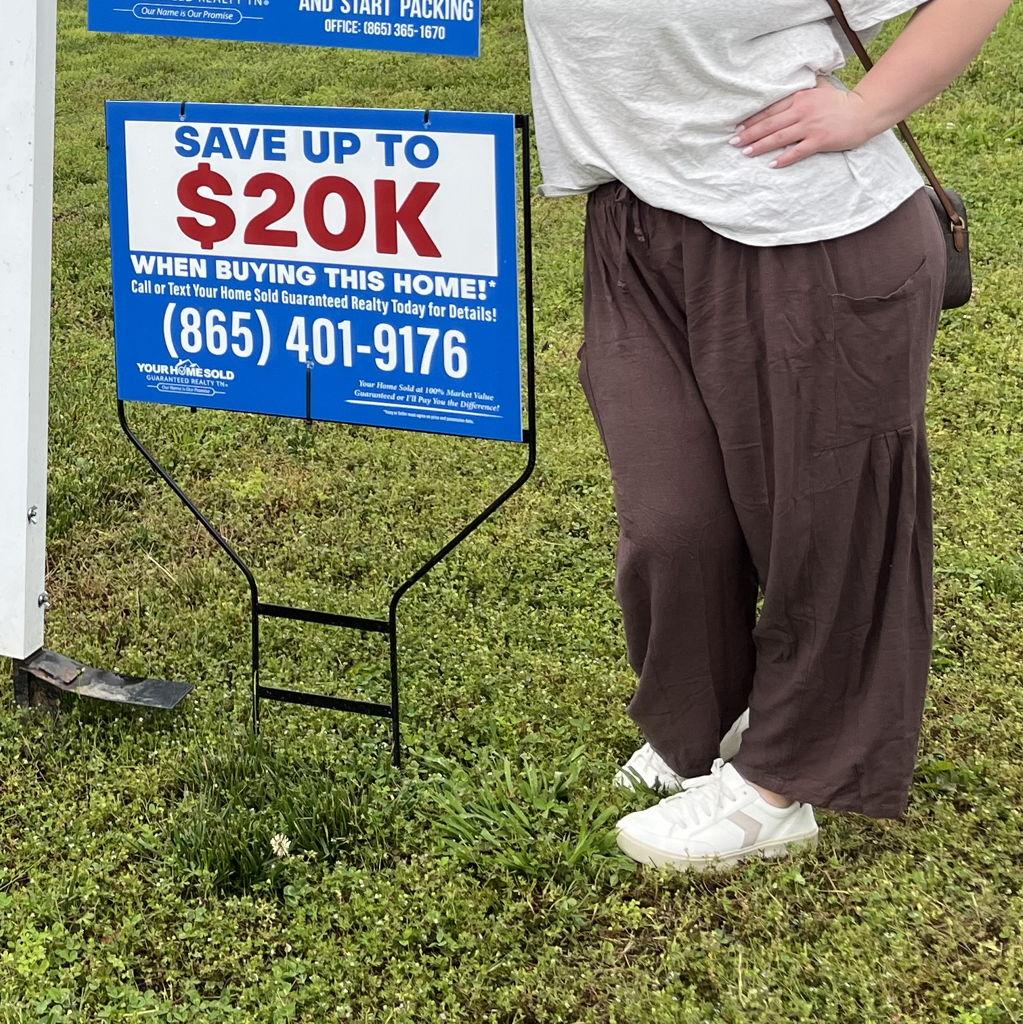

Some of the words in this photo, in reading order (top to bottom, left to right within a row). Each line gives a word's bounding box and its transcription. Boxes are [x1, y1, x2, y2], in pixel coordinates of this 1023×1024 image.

[141, 6, 156, 15] Our
[156, 8, 179, 17] Name
[187, 9, 202, 18] Our
[203, 10, 233, 20] Promise
[325, 19, 361, 34] OFFICE:
[364, 21, 392, 36] (865)
[394, 23, 445, 40] 365-1670
[175, 126, 286, 161] SAVE
[303, 130, 361, 164] UP
[376, 133, 439, 169] TO
[177, 162, 442, 258] $20K
[130, 254, 207, 278] WHEN
[216, 260, 317, 286] BUYING
[324, 267, 385, 291] THIS
[131, 279, 151, 293] Call
[154, 284, 166, 294] or
[168, 282, 191, 296] Text
[193, 284, 218, 298] Your
[220, 286, 252, 301] Home
[254, 288, 279, 303] Sold
[281, 290, 348, 309] Guaranteed
[351, 296, 389, 315] Realty
[391, 299, 426, 319] Today
[428, 302, 446, 317] for
[449, 304, 496, 322] Details!
[163, 302, 271, 366] (865)
[286, 316, 468, 379] 401-9176
